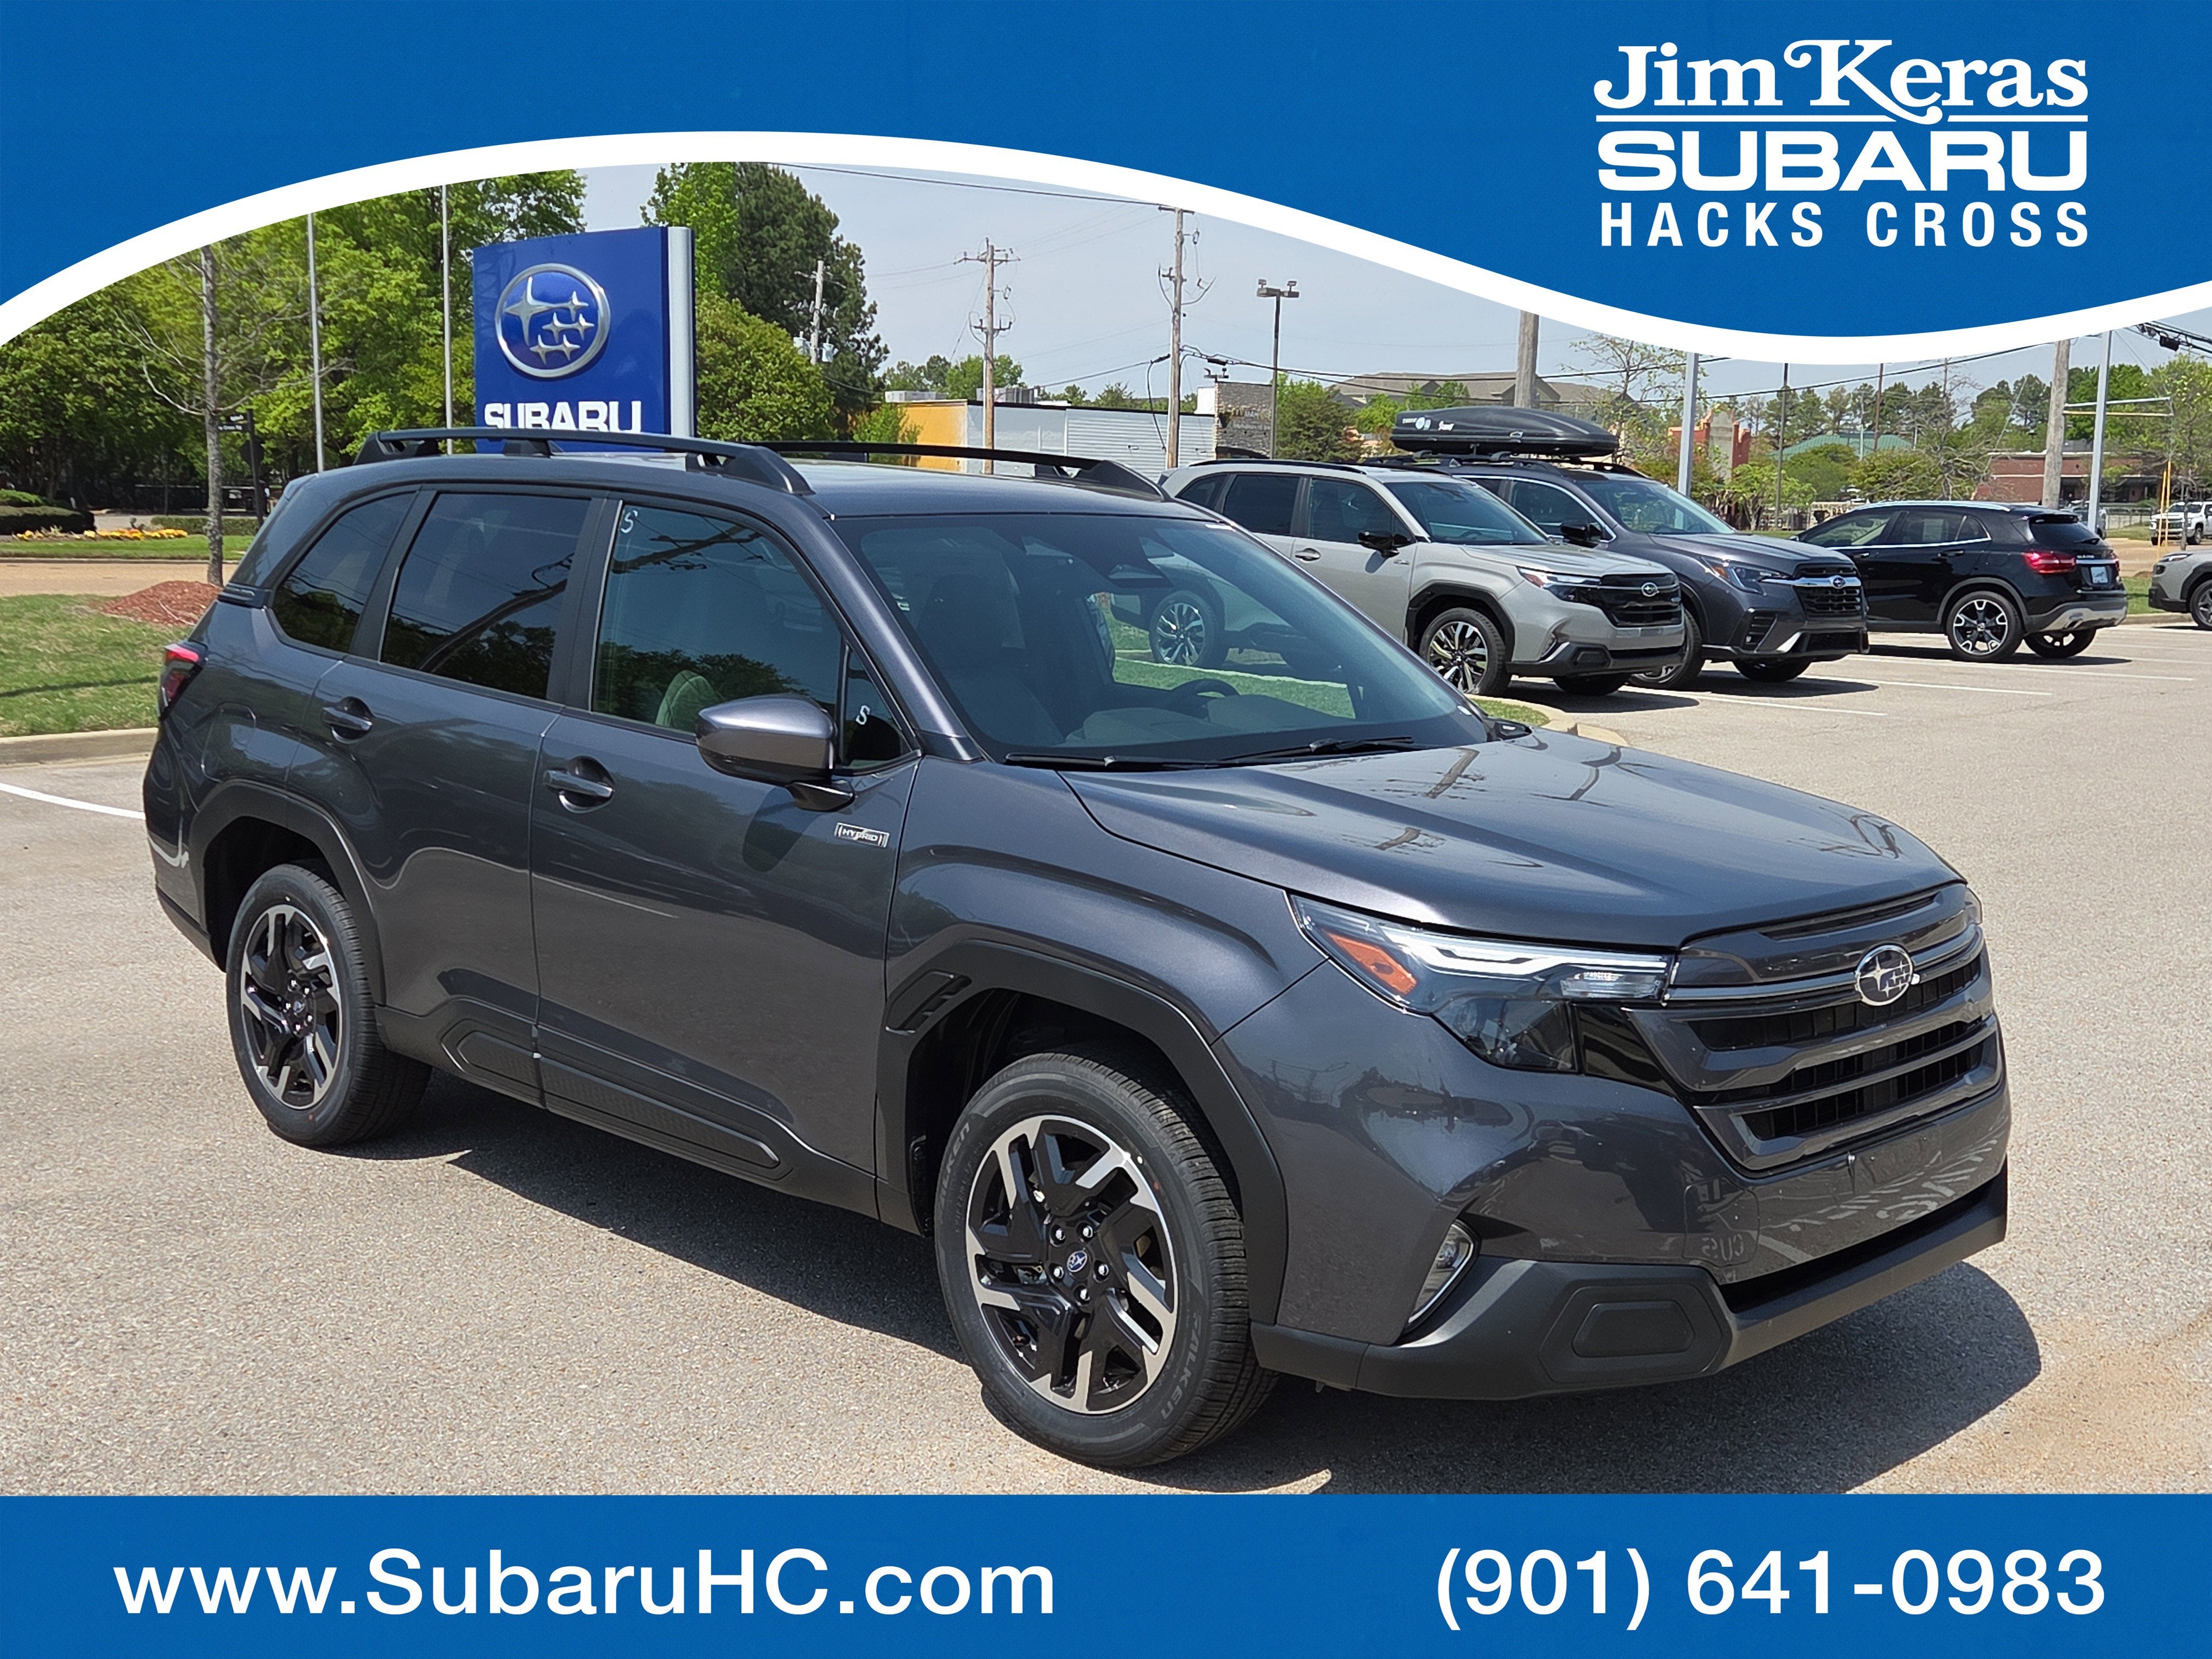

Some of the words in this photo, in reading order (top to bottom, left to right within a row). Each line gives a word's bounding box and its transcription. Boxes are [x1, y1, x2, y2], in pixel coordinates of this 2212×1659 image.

[484, 401, 642, 433] SUBARU
[842, 828, 879, 841] HYBRID
[1160, 1310, 1202, 1420] FALKEN
